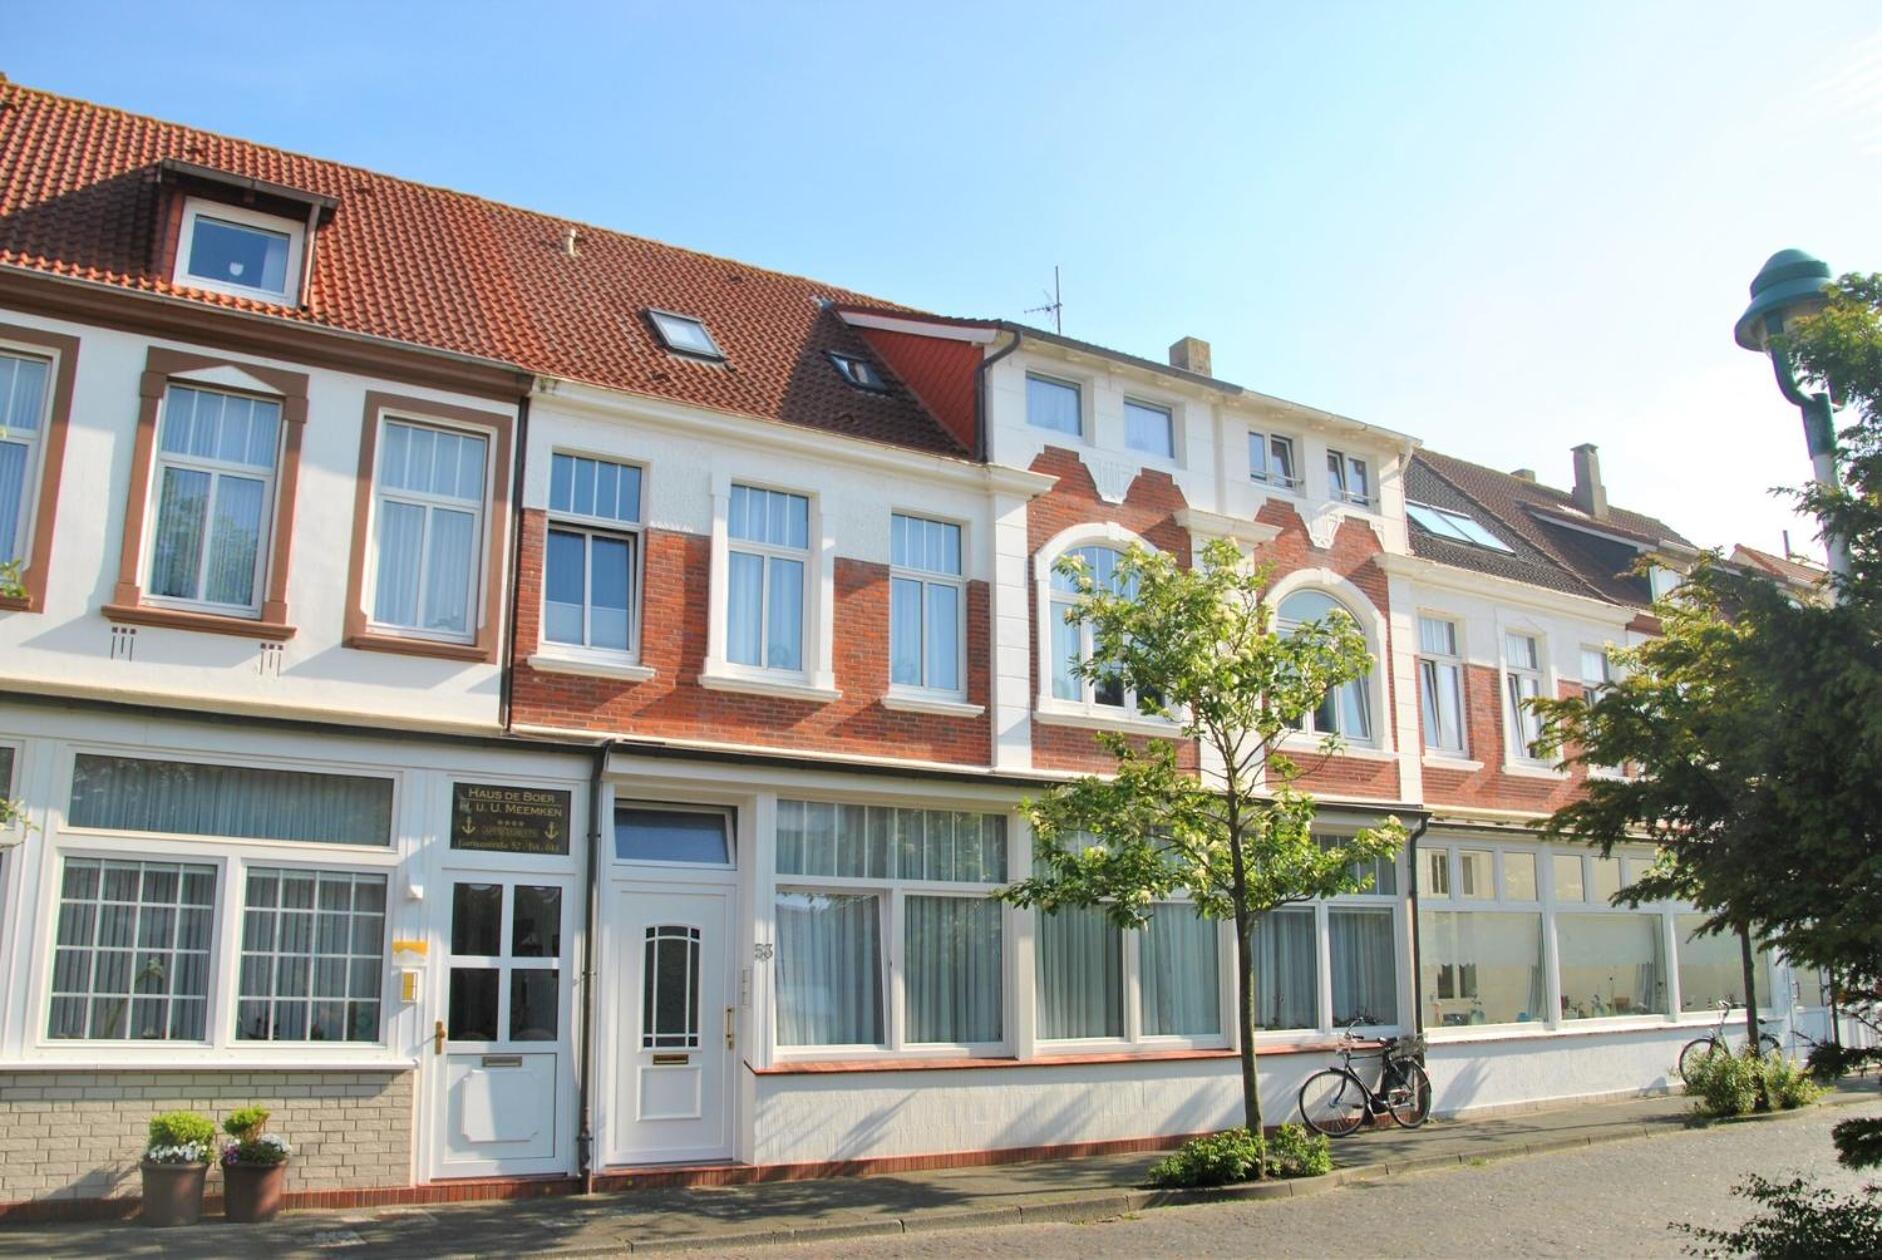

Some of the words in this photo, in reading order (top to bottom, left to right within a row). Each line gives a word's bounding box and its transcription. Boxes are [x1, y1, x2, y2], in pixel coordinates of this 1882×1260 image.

[468, 787, 502, 800] HAUS
[505, 792, 521, 801] DE
[523, 791, 556, 803] BOER
[505, 803, 563, 817] MEEMKEN
[755, 943, 773, 960] 53
